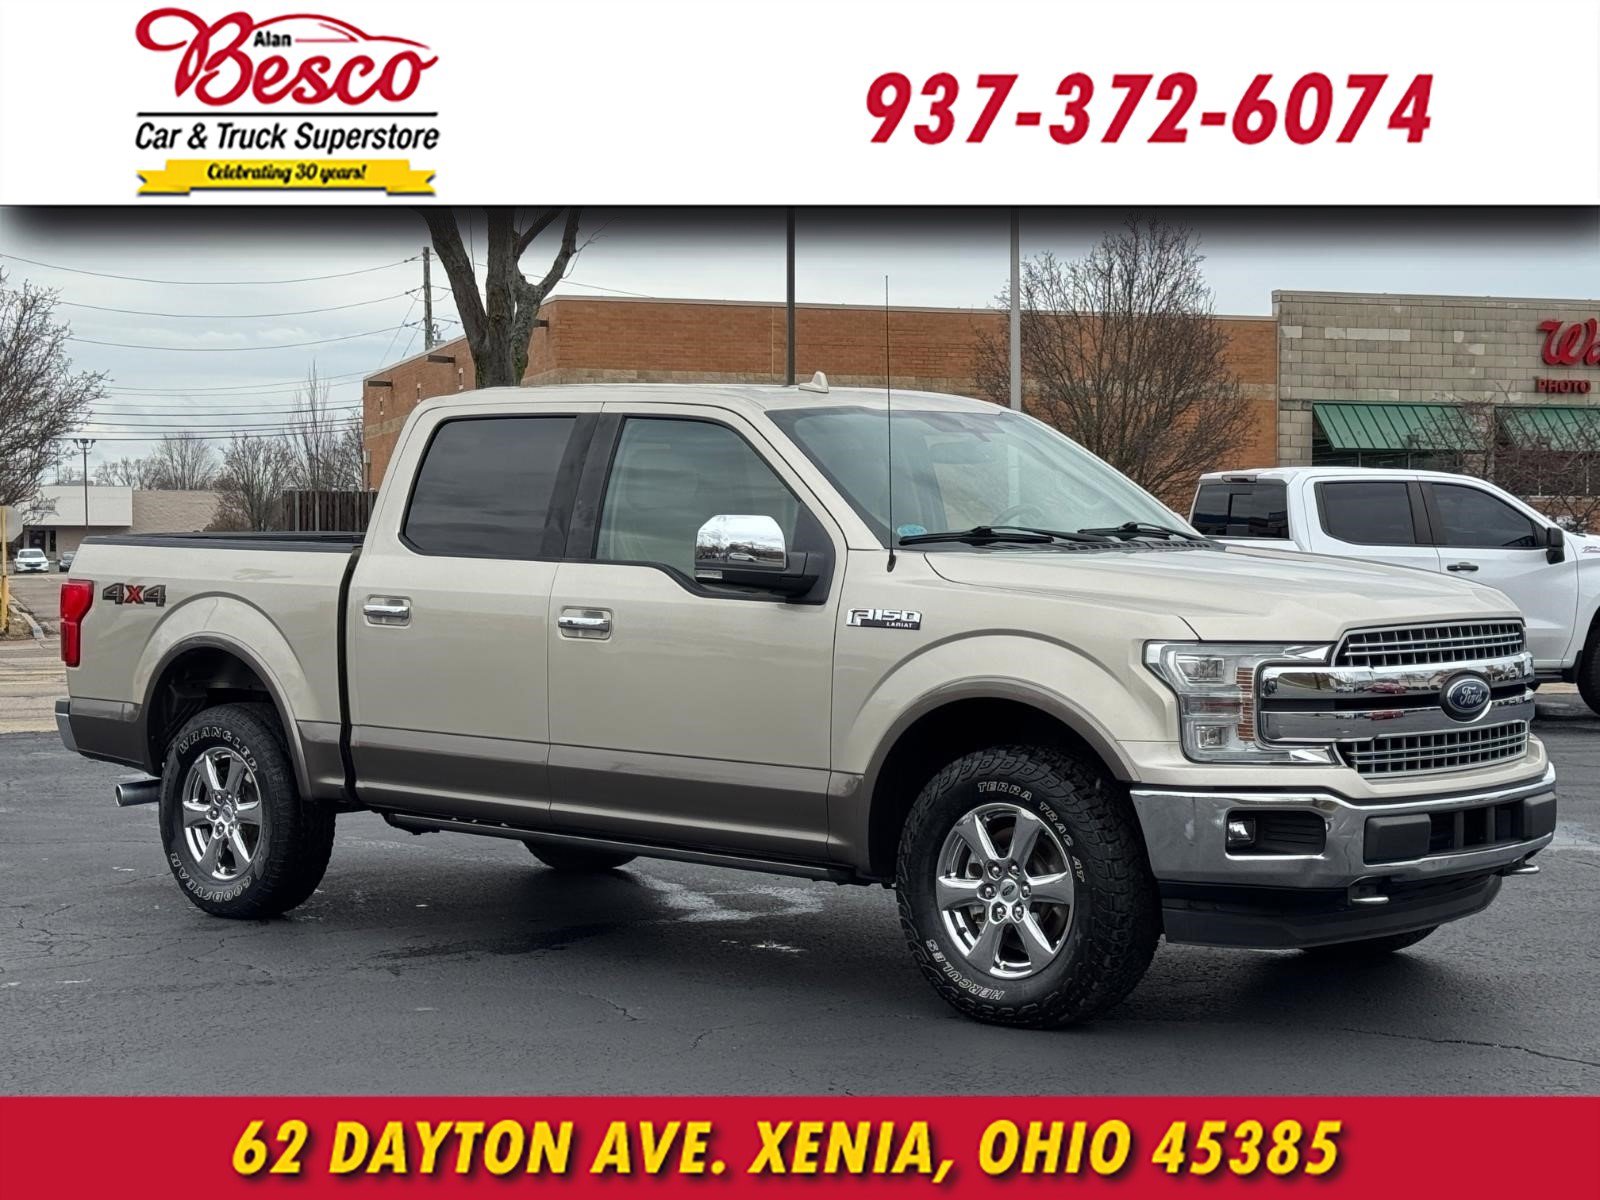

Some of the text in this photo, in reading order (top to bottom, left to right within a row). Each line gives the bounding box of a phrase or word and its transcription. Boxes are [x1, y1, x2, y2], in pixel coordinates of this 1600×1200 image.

[1535, 379, 1591, 394] PHOTO
[886, 621, 913, 629] LARIAT
[1460, 686, 1483, 705] Ford
[178, 726, 258, 773] WRANGLER
[977, 781, 1033, 801] TERRA
[1039, 801, 1074, 847] TRAC
[170, 852, 252, 903] GOODYEAR
[925, 939, 1006, 1000] HERCULES
